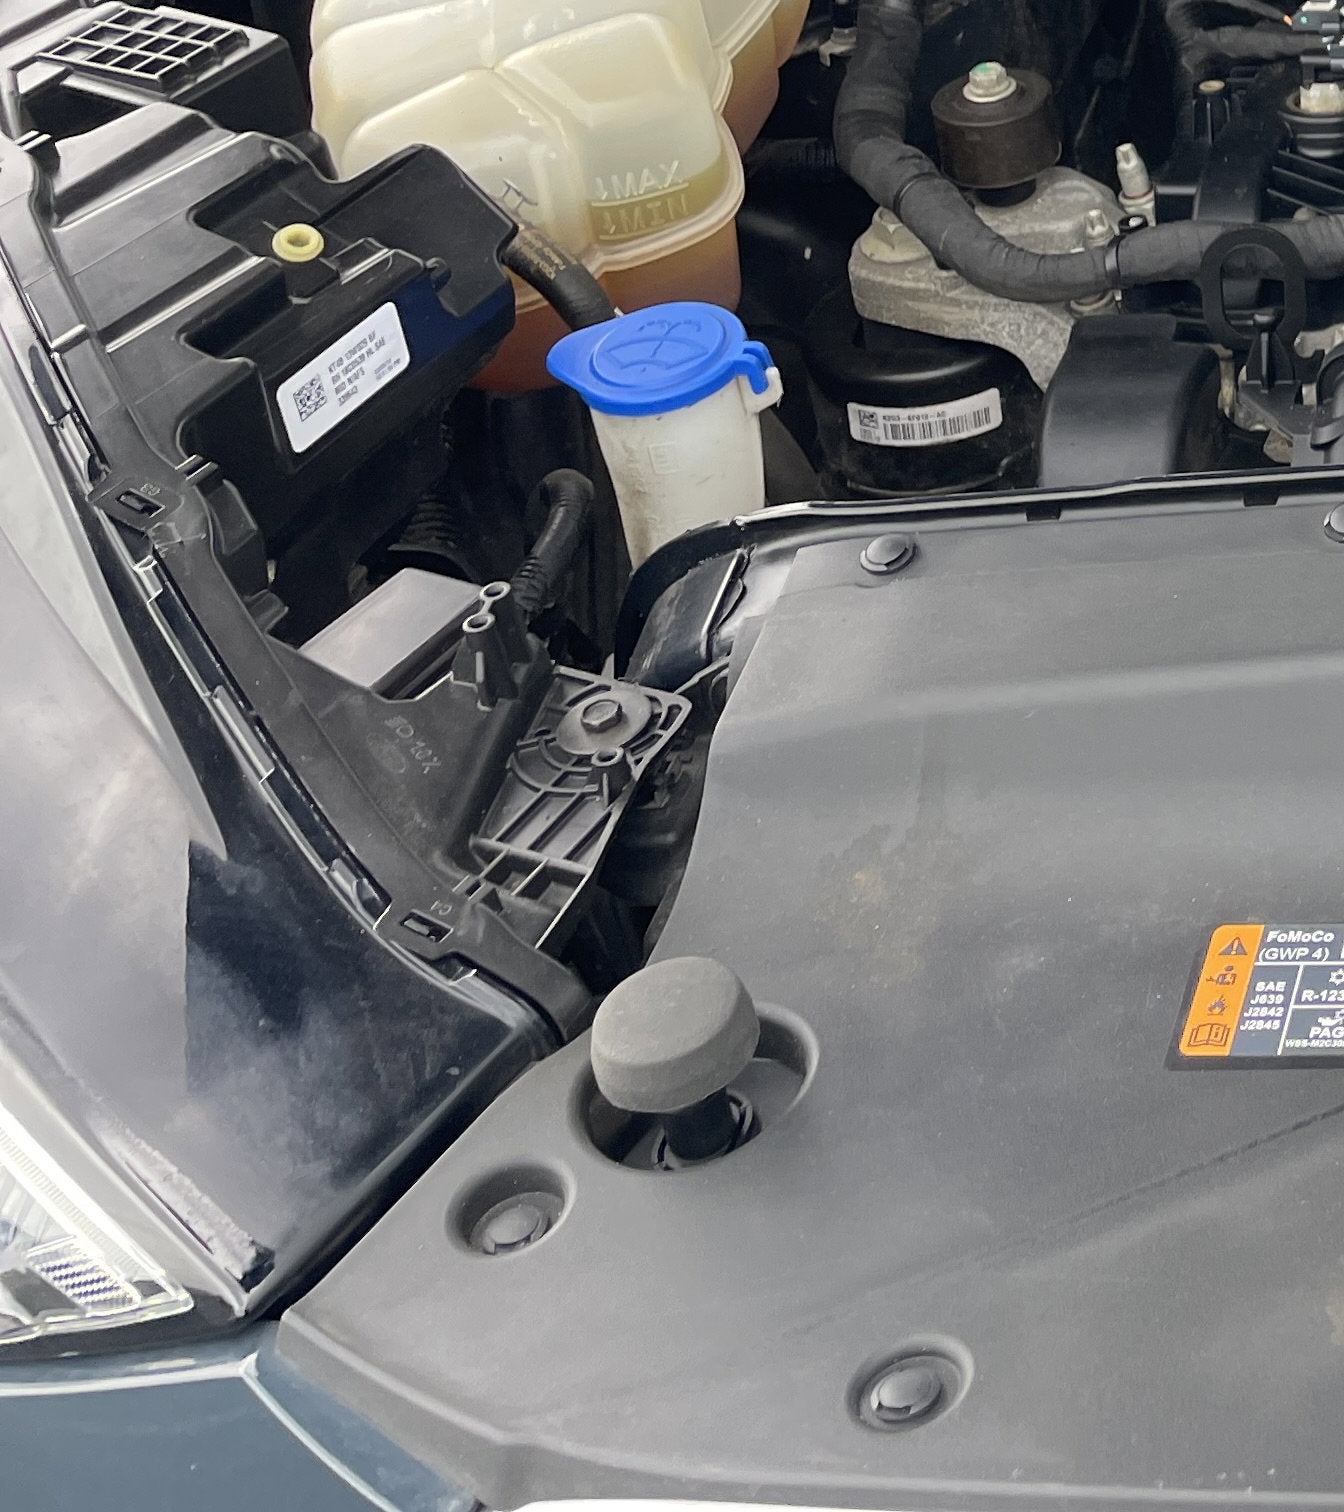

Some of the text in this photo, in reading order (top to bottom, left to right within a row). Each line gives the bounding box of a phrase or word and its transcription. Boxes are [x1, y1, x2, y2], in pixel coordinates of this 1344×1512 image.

[612, 160, 683, 199] MAX
[621, 194, 689, 233] MIN
[1266, 930, 1335, 943] FoMoCo
[1258, 947, 1330, 962] (GWP 4)
[1255, 981, 1287, 992] SAE
